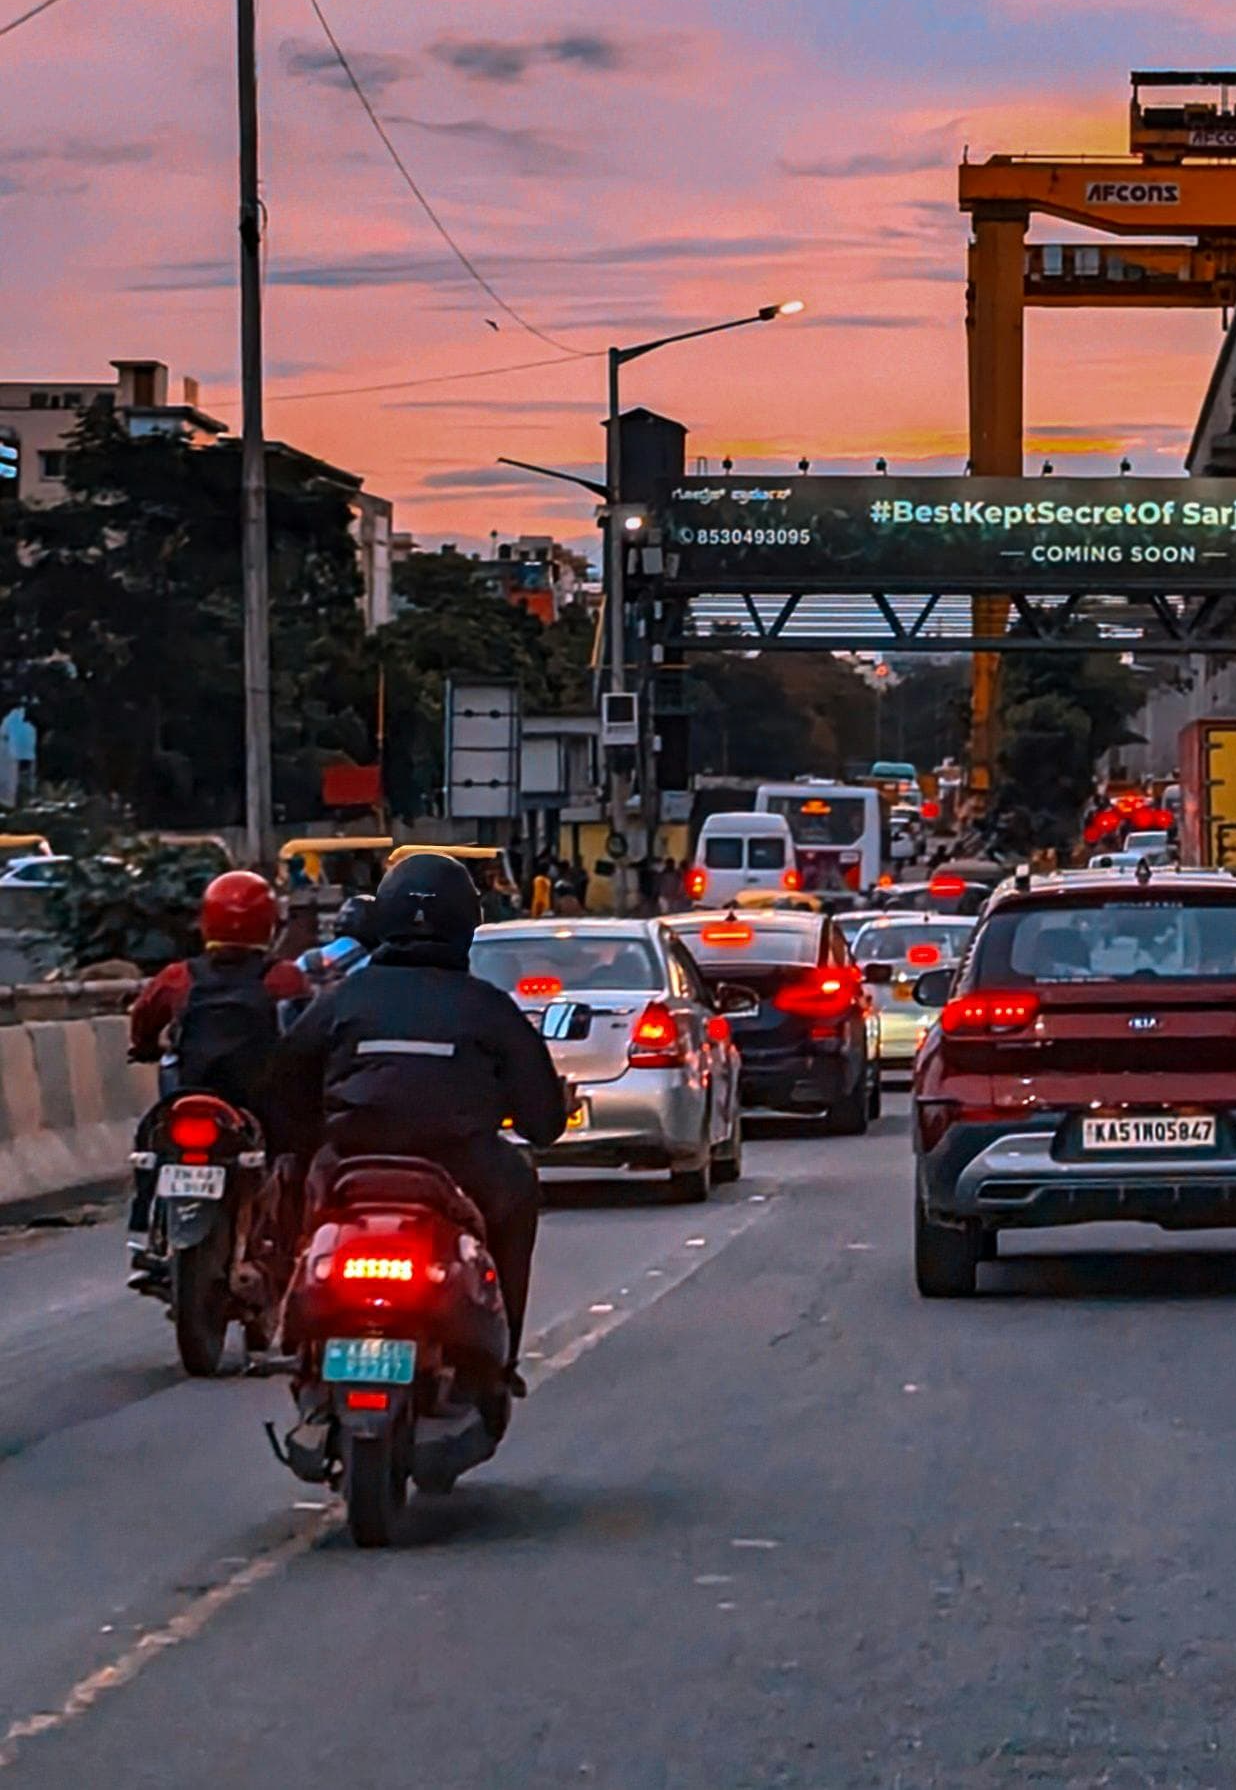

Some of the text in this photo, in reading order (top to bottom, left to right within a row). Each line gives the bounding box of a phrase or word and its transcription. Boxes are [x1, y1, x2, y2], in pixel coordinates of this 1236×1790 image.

[1087, 183, 1179, 202] AFCONS
[870, 500, 1175, 529] #BestKeptSecretOf
[697, 528, 811, 545] 8530493095
[1031, 545, 1196, 563] COMING SOON
